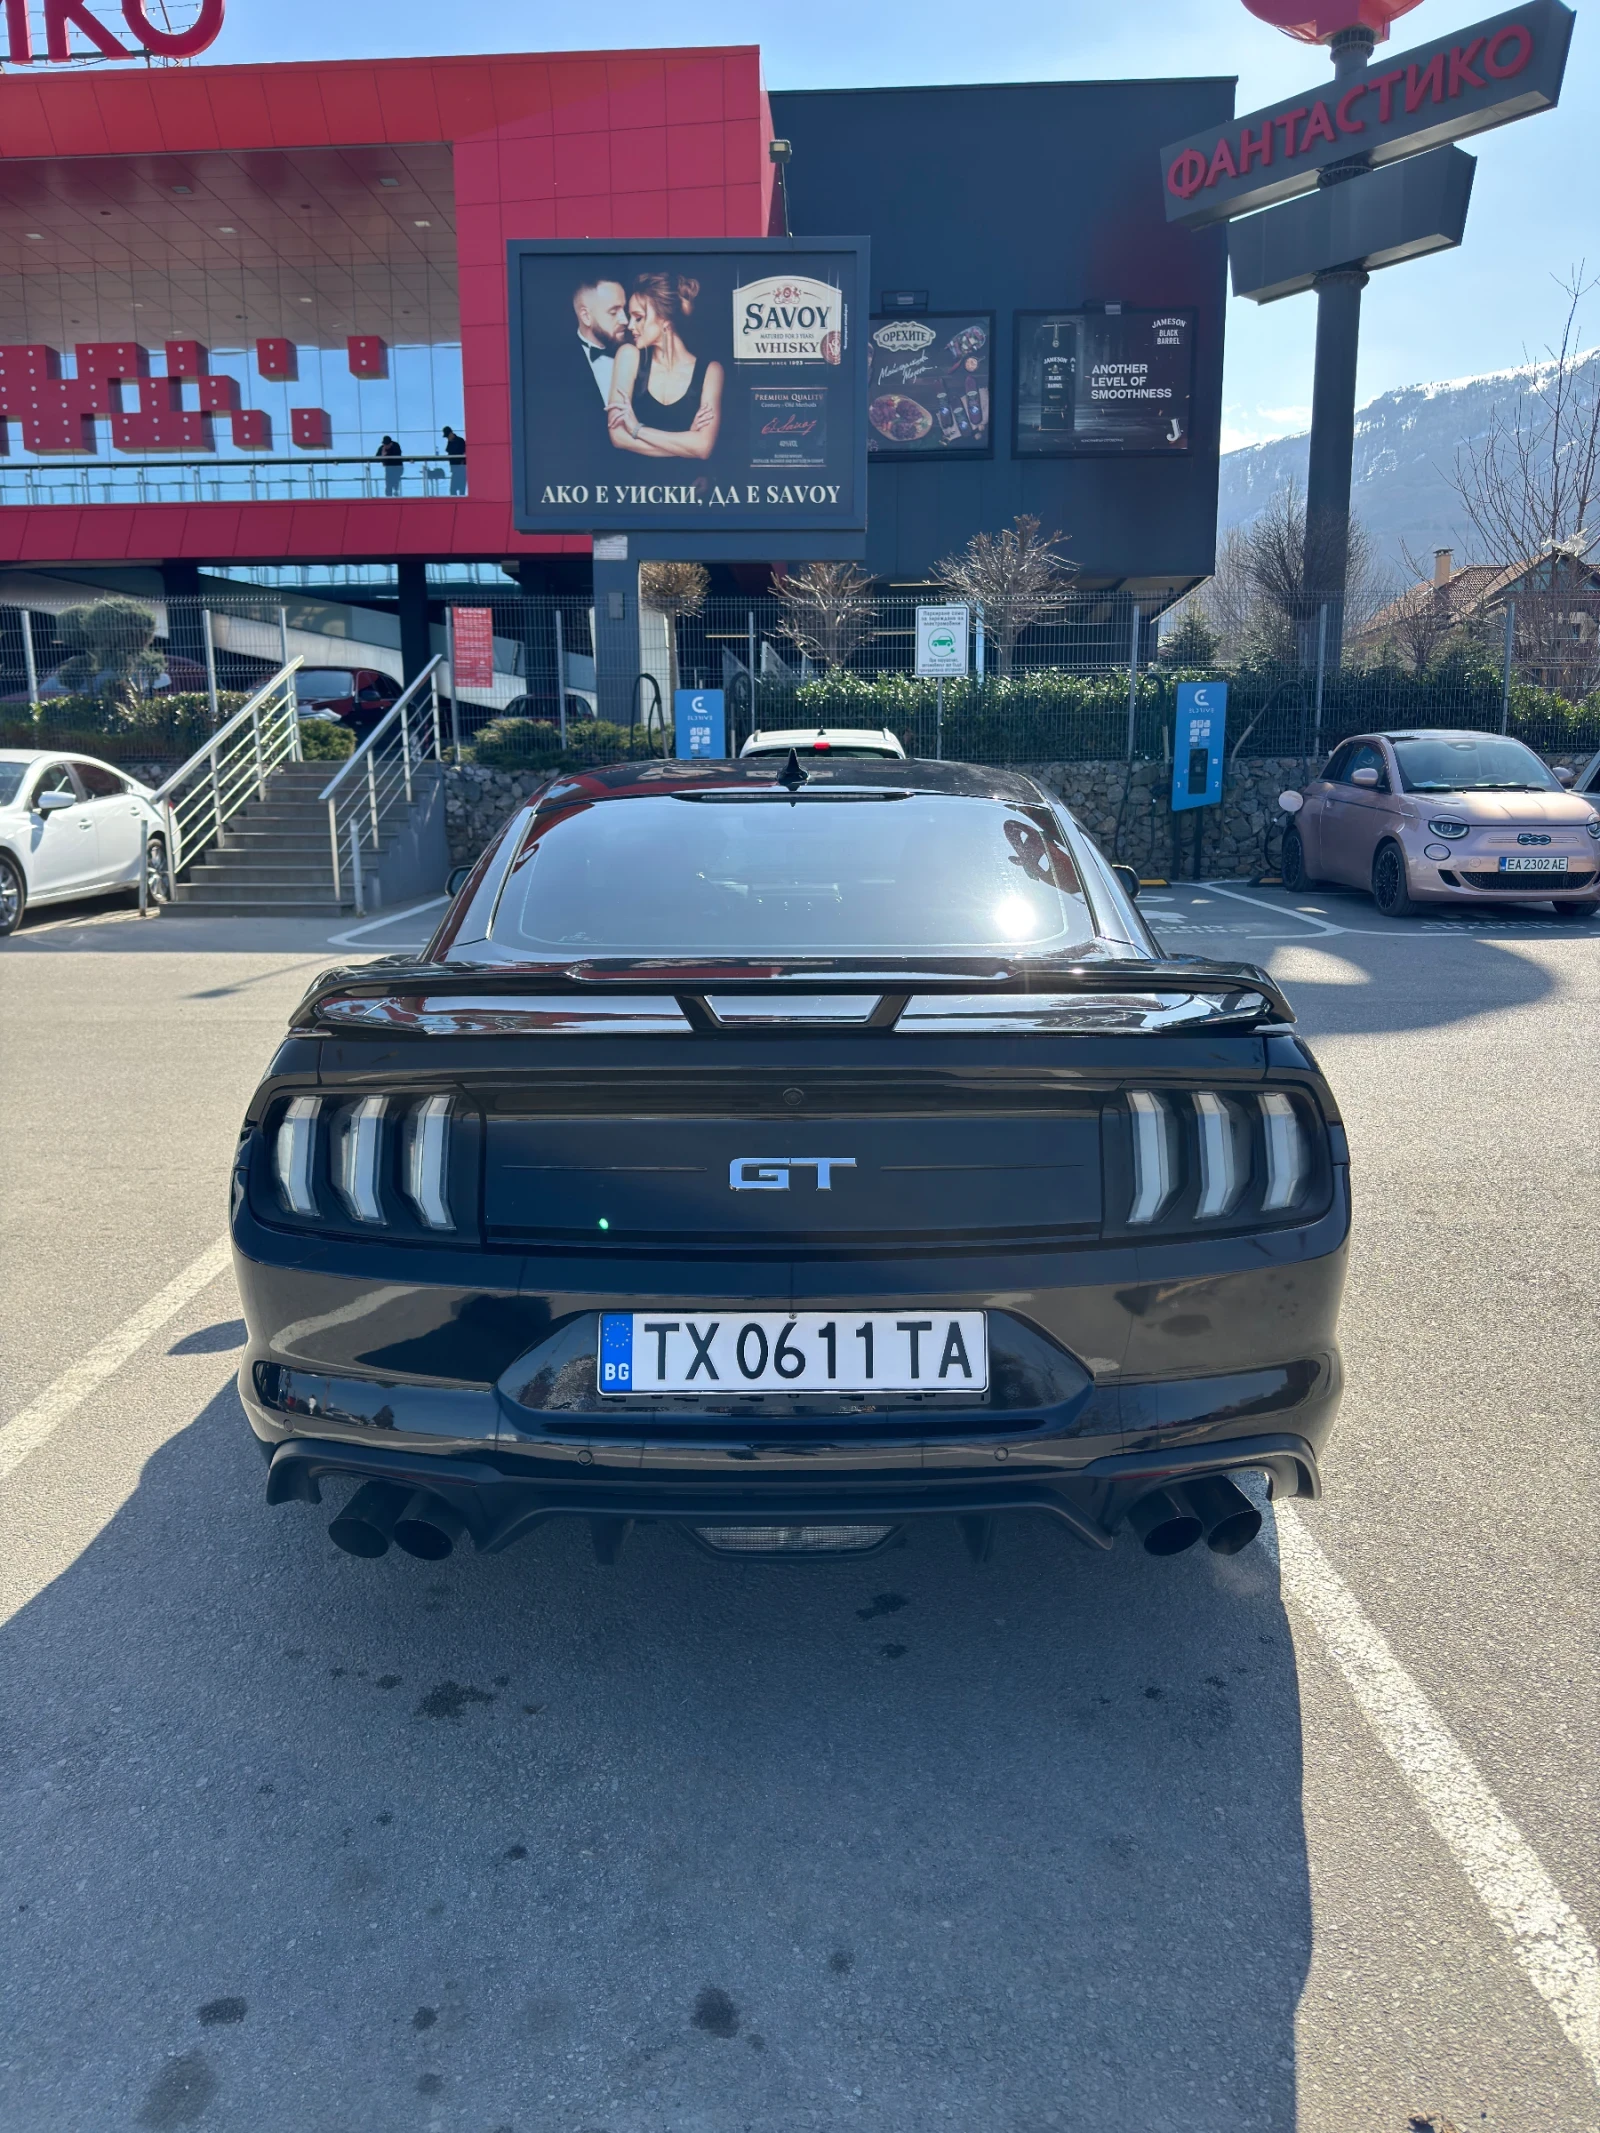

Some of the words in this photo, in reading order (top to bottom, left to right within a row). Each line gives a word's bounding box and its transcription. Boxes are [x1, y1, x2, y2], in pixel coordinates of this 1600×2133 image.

[1167, 23, 1535, 200] ФАНТАСТИКО
[743, 303, 832, 334] SAVOY
[1151, 317, 1187, 329] JAMESON
[882, 330, 927, 342] ОРЕХИТЕ
[1159, 329, 1178, 337] BLACK
[1156, 337, 1181, 345] BARREL
[755, 342, 820, 353] WHISKY
[1091, 364, 1148, 375] ANOTHER
[1091, 377, 1128, 387] LEVEL
[1130, 376, 1147, 386] OF
[754, 393, 789, 401] PREMIUM
[791, 393, 824, 402] QUALITY
[1091, 388, 1172, 400] SMOOTHNESS
[541, 485, 589, 504] АКО
[595, 485, 608, 504] Е
[615, 485, 703, 506] УИСКИ,
[708, 485, 740, 507] ДА
[747, 485, 759, 504] Е
[766, 485, 841, 504] SAVOY
[1518, 833, 1551, 846] 500
[1507, 859, 1522, 870] EA
[1523, 859, 1550, 870] 2302
[1551, 859, 1566, 870] AE
[728, 1156, 858, 1192] GT
[644, 1321, 719, 1381] TX
[735, 1321, 875, 1380] 0611
[895, 1320, 973, 1379] TA
[603, 1363, 630, 1381] BG
